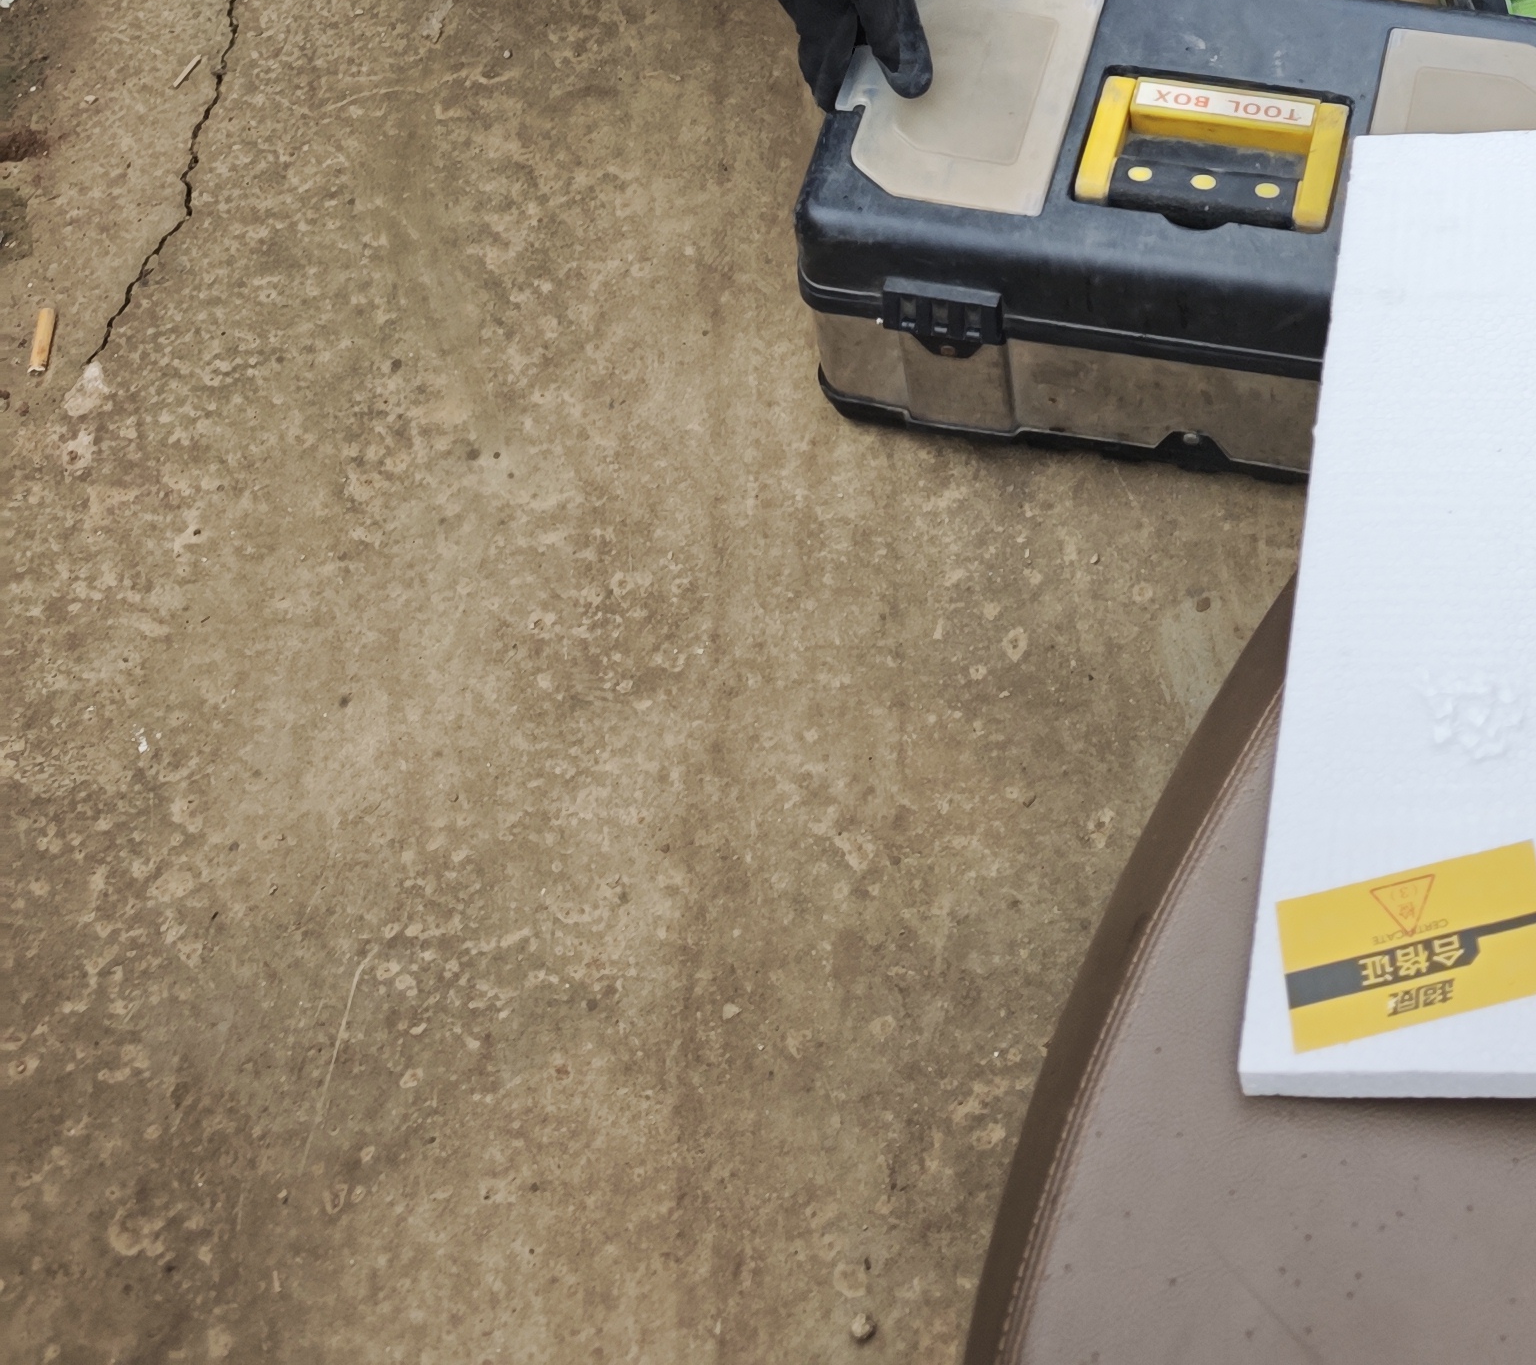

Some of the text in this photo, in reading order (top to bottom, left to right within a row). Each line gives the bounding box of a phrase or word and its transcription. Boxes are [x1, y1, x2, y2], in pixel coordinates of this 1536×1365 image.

[1153, 89, 1302, 122] TOOL BOX
[1371, 919, 1450, 945] CERTIFICATE
[1357, 933, 1466, 987] 合格证
[1386, 978, 1456, 1018] 超威
